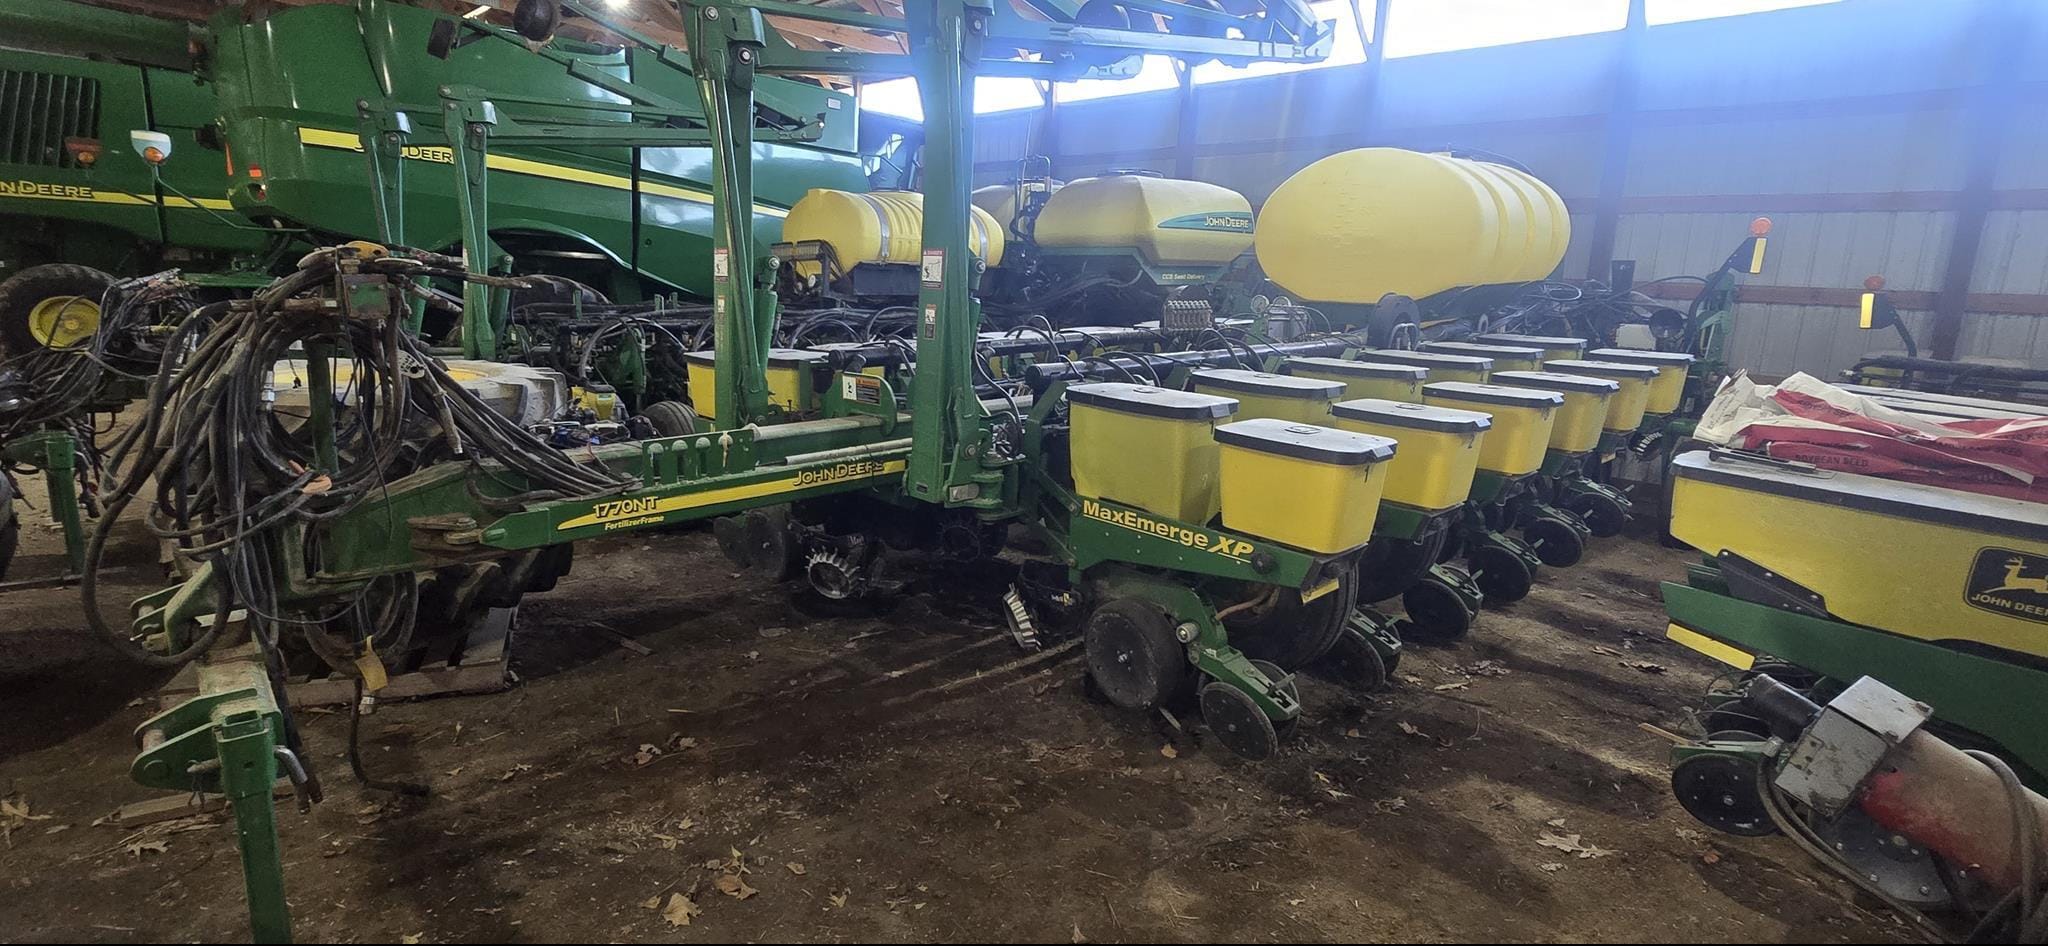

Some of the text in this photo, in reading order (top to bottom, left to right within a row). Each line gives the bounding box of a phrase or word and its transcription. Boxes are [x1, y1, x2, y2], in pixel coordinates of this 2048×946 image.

[407, 145, 454, 163] DEER
[19, 179, 92, 198] DEERE
[1204, 215, 1249, 228] JOHN DEERE
[793, 467, 834, 486] JOHN
[592, 496, 659, 518] 1770NT
[604, 515, 665, 531] FertilizerFrame
[1082, 499, 1255, 556] MaxEmerge XP
[1971, 593, 2012, 608] JOHN
